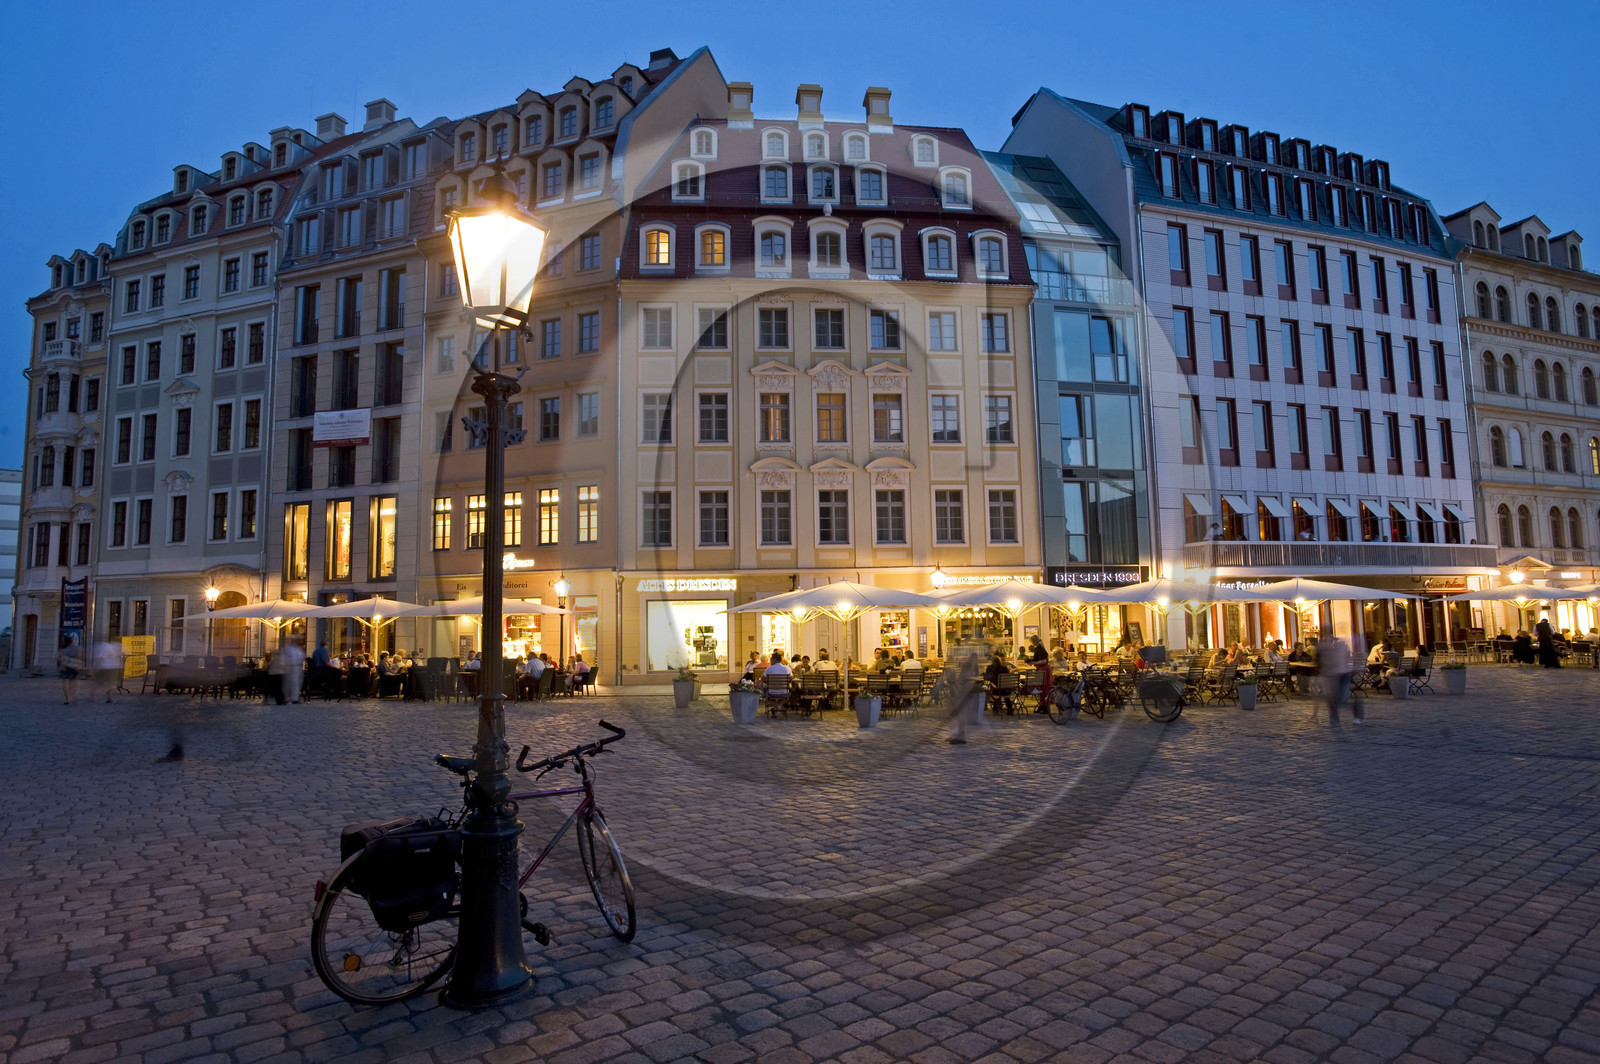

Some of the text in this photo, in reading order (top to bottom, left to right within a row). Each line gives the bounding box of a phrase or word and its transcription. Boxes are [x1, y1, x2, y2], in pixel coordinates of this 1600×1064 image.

[1055, 572, 1140, 582] DRESDEN 1900
[456, 583, 467, 591] Eis
[676, 579, 736, 591] DRESDEN
